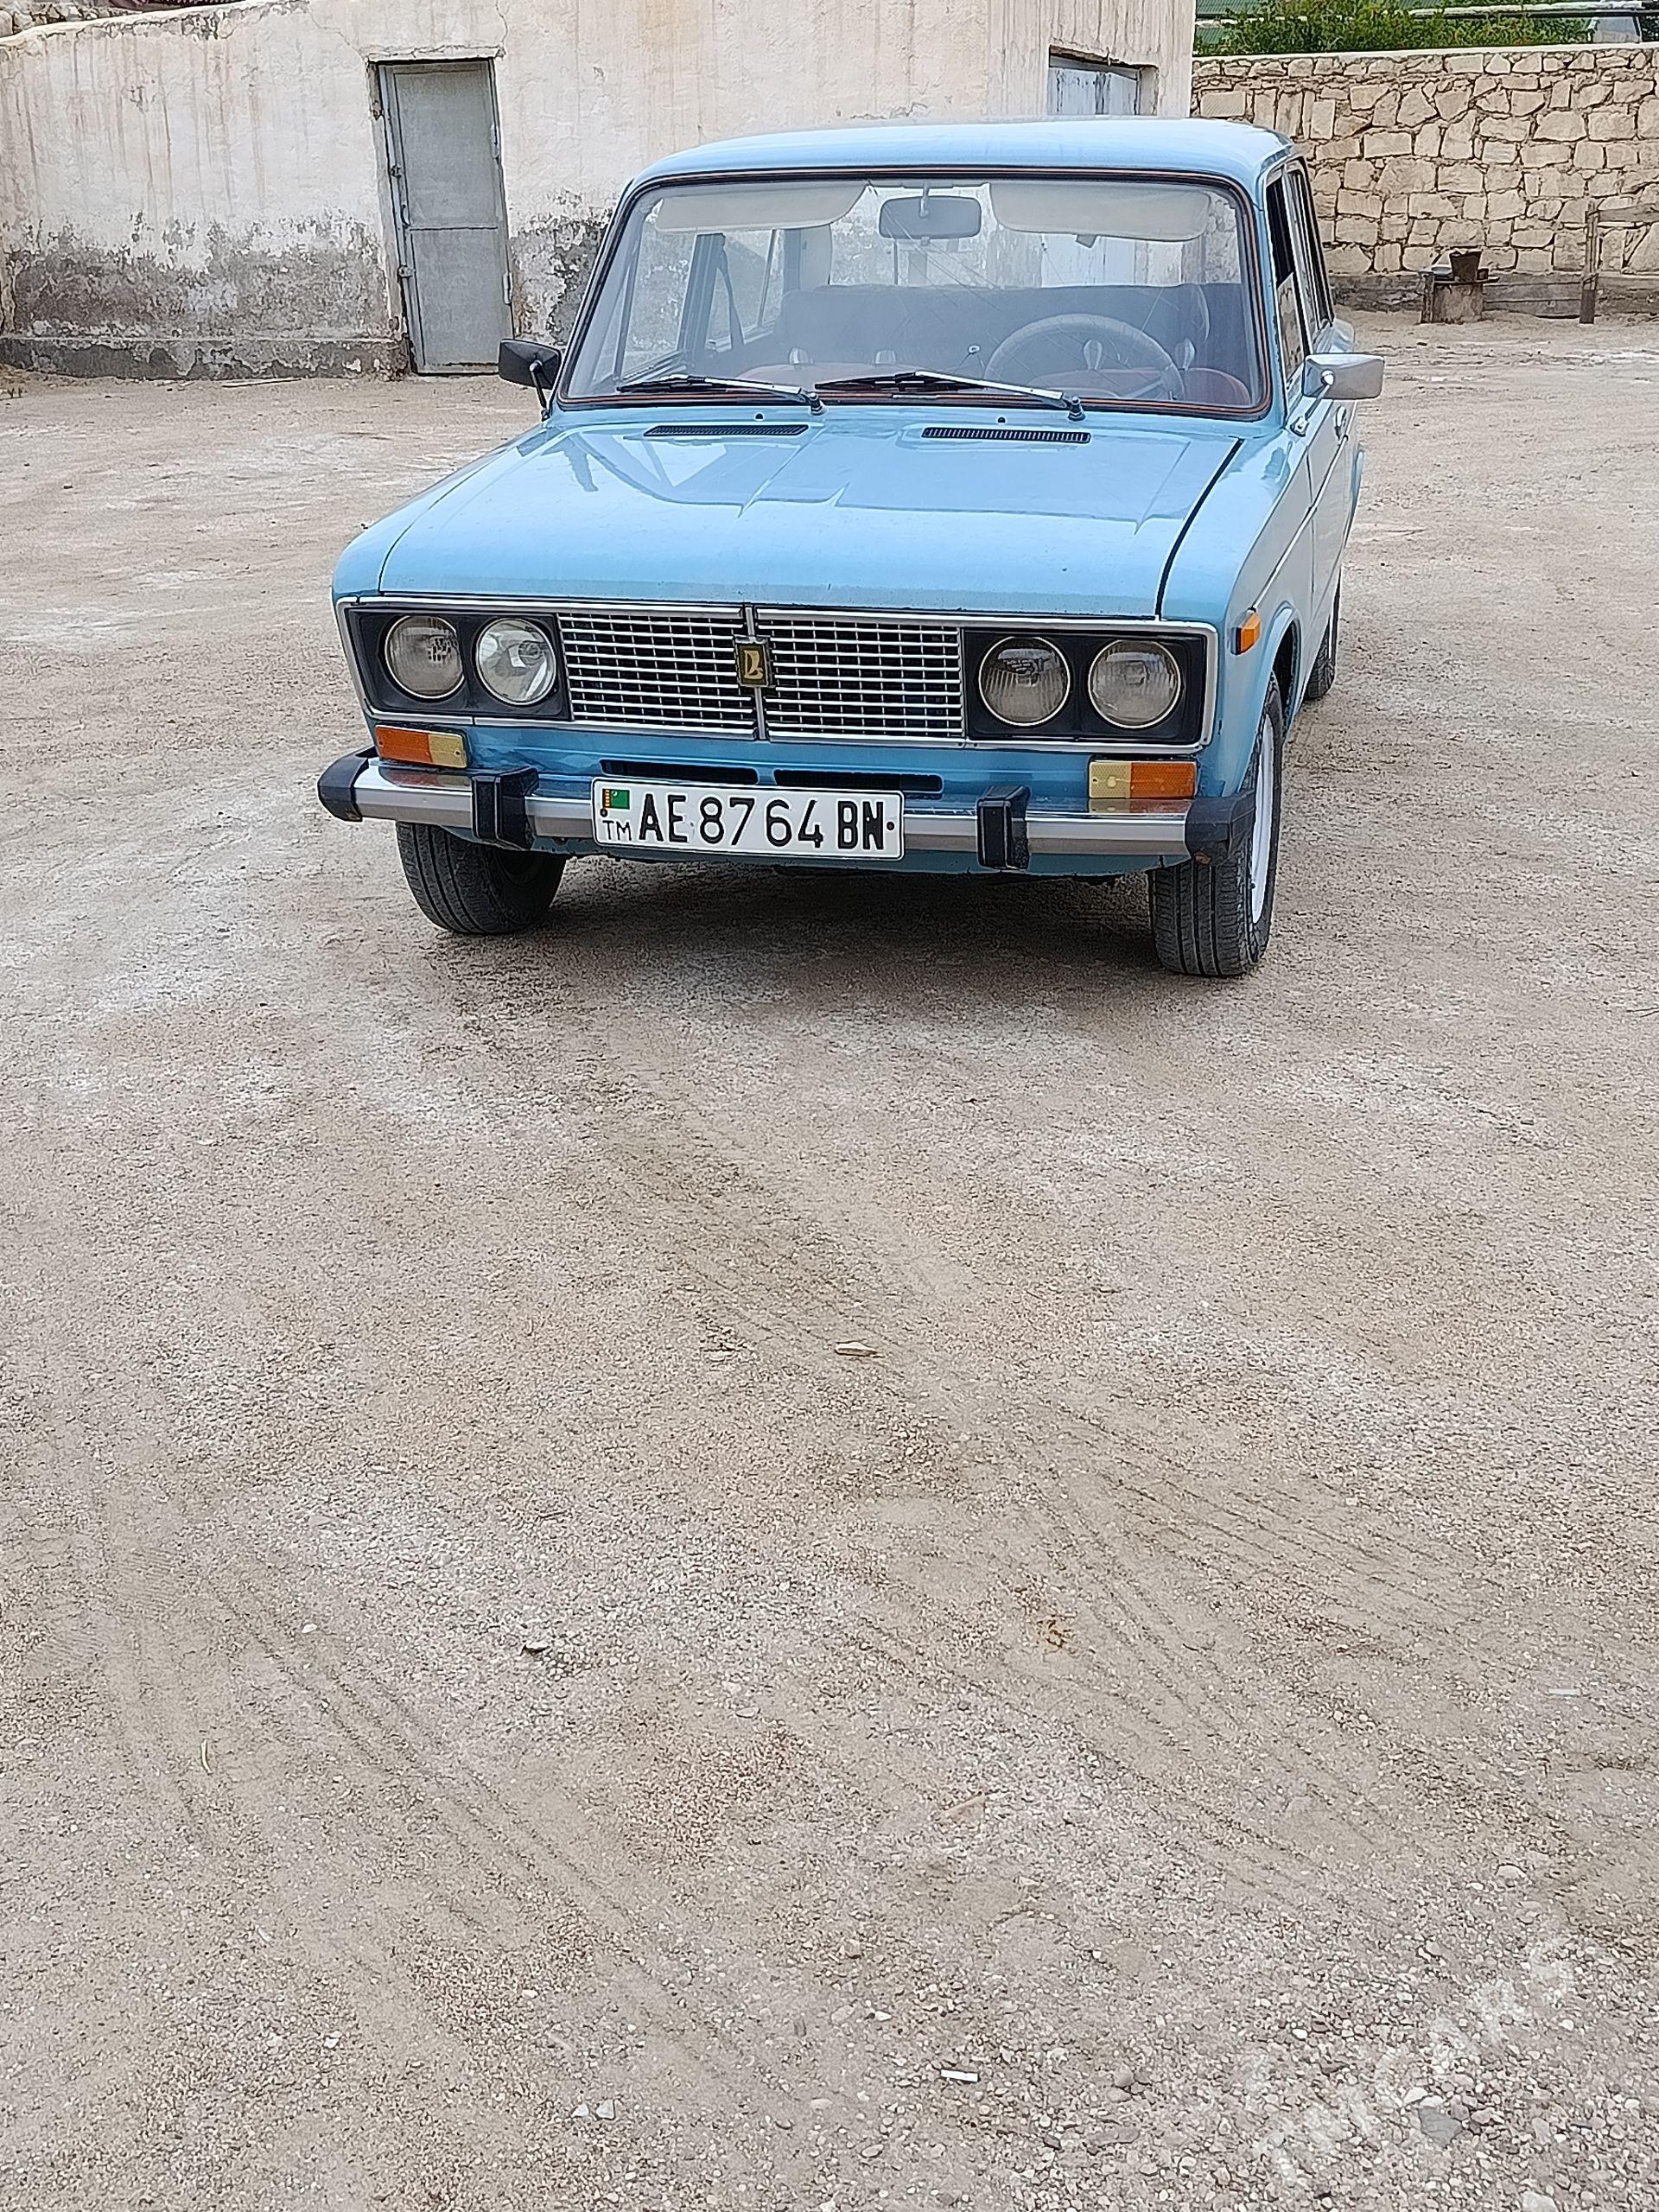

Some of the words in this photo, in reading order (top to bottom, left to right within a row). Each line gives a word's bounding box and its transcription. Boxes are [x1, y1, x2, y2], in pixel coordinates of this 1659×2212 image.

[603, 820, 632, 842] TM
[639, 793, 689, 843] AE
[836, 800, 885, 850] BN
